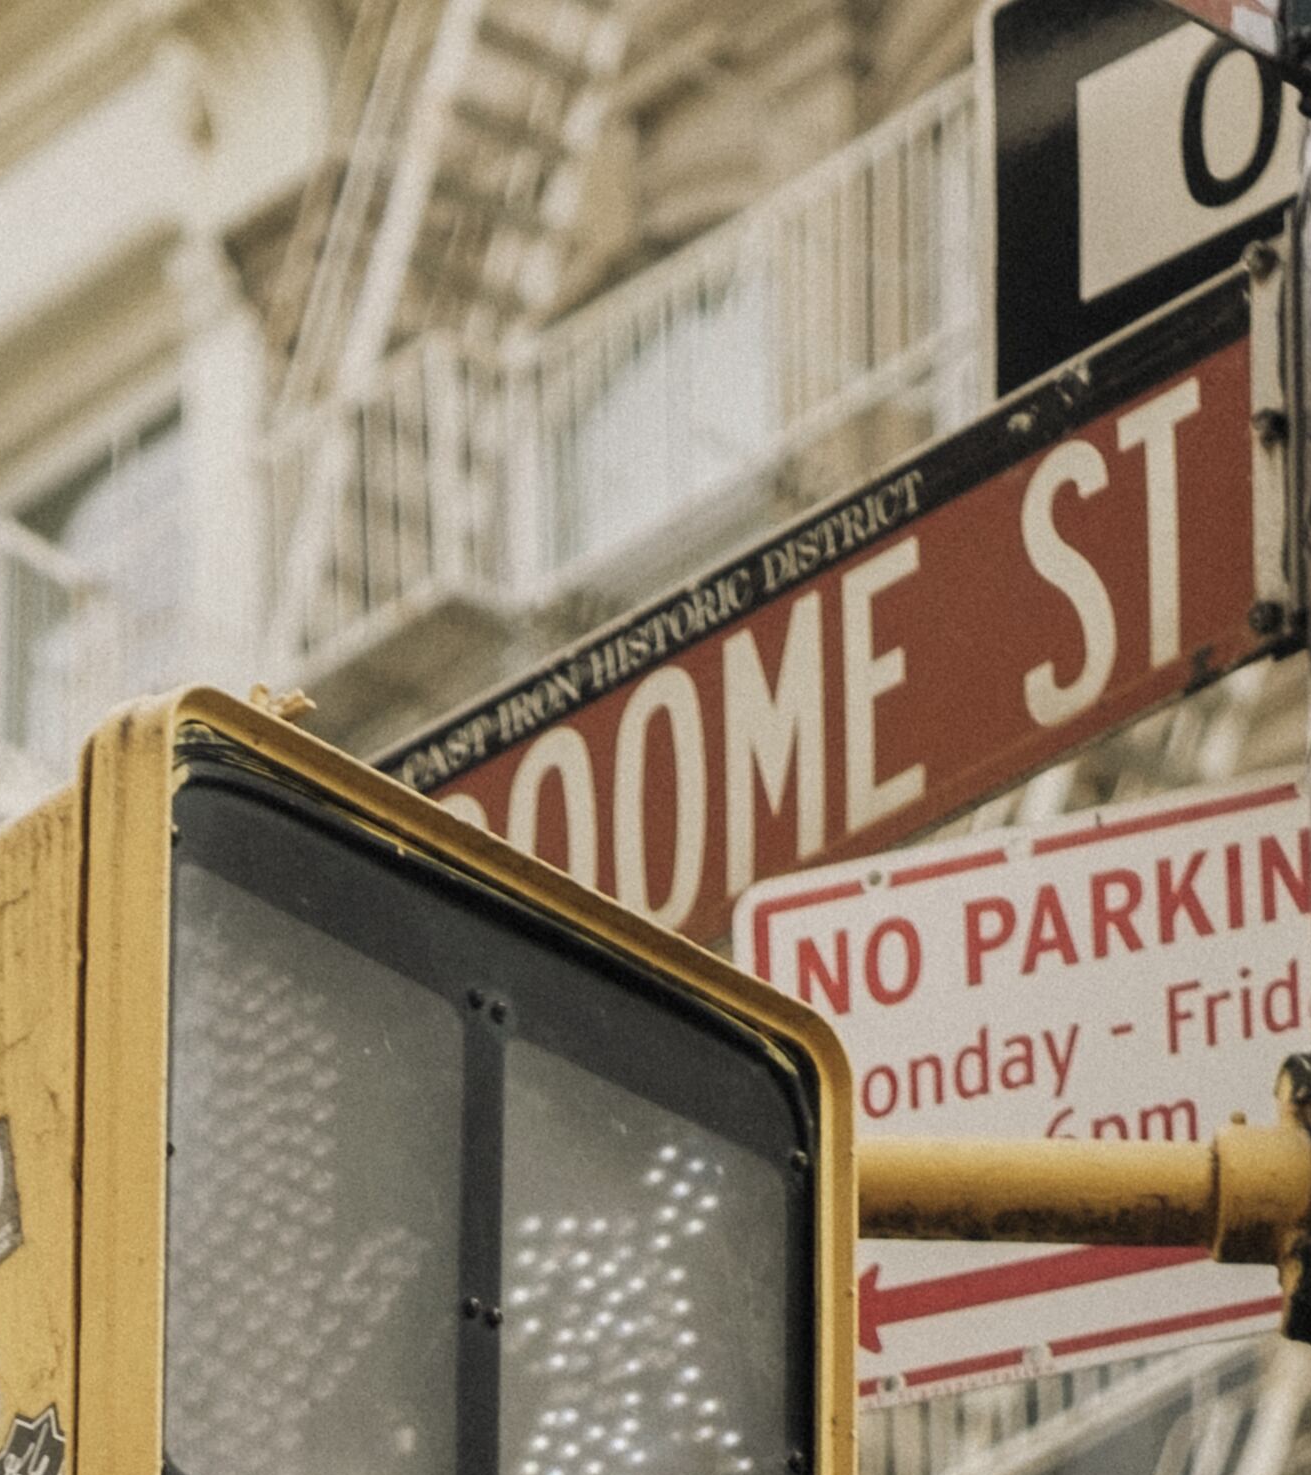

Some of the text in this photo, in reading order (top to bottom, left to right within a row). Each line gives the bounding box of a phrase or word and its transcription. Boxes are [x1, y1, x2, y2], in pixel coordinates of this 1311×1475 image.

[401, 469, 925, 788] CAST IRON HISTORIC DISTRICT
[1020, 377, 1202, 728] ST
[794, 914, 921, 1018] NO
[860, 1023, 1079, 1120] onday
[1165, 958, 1301, 1055] Frid
